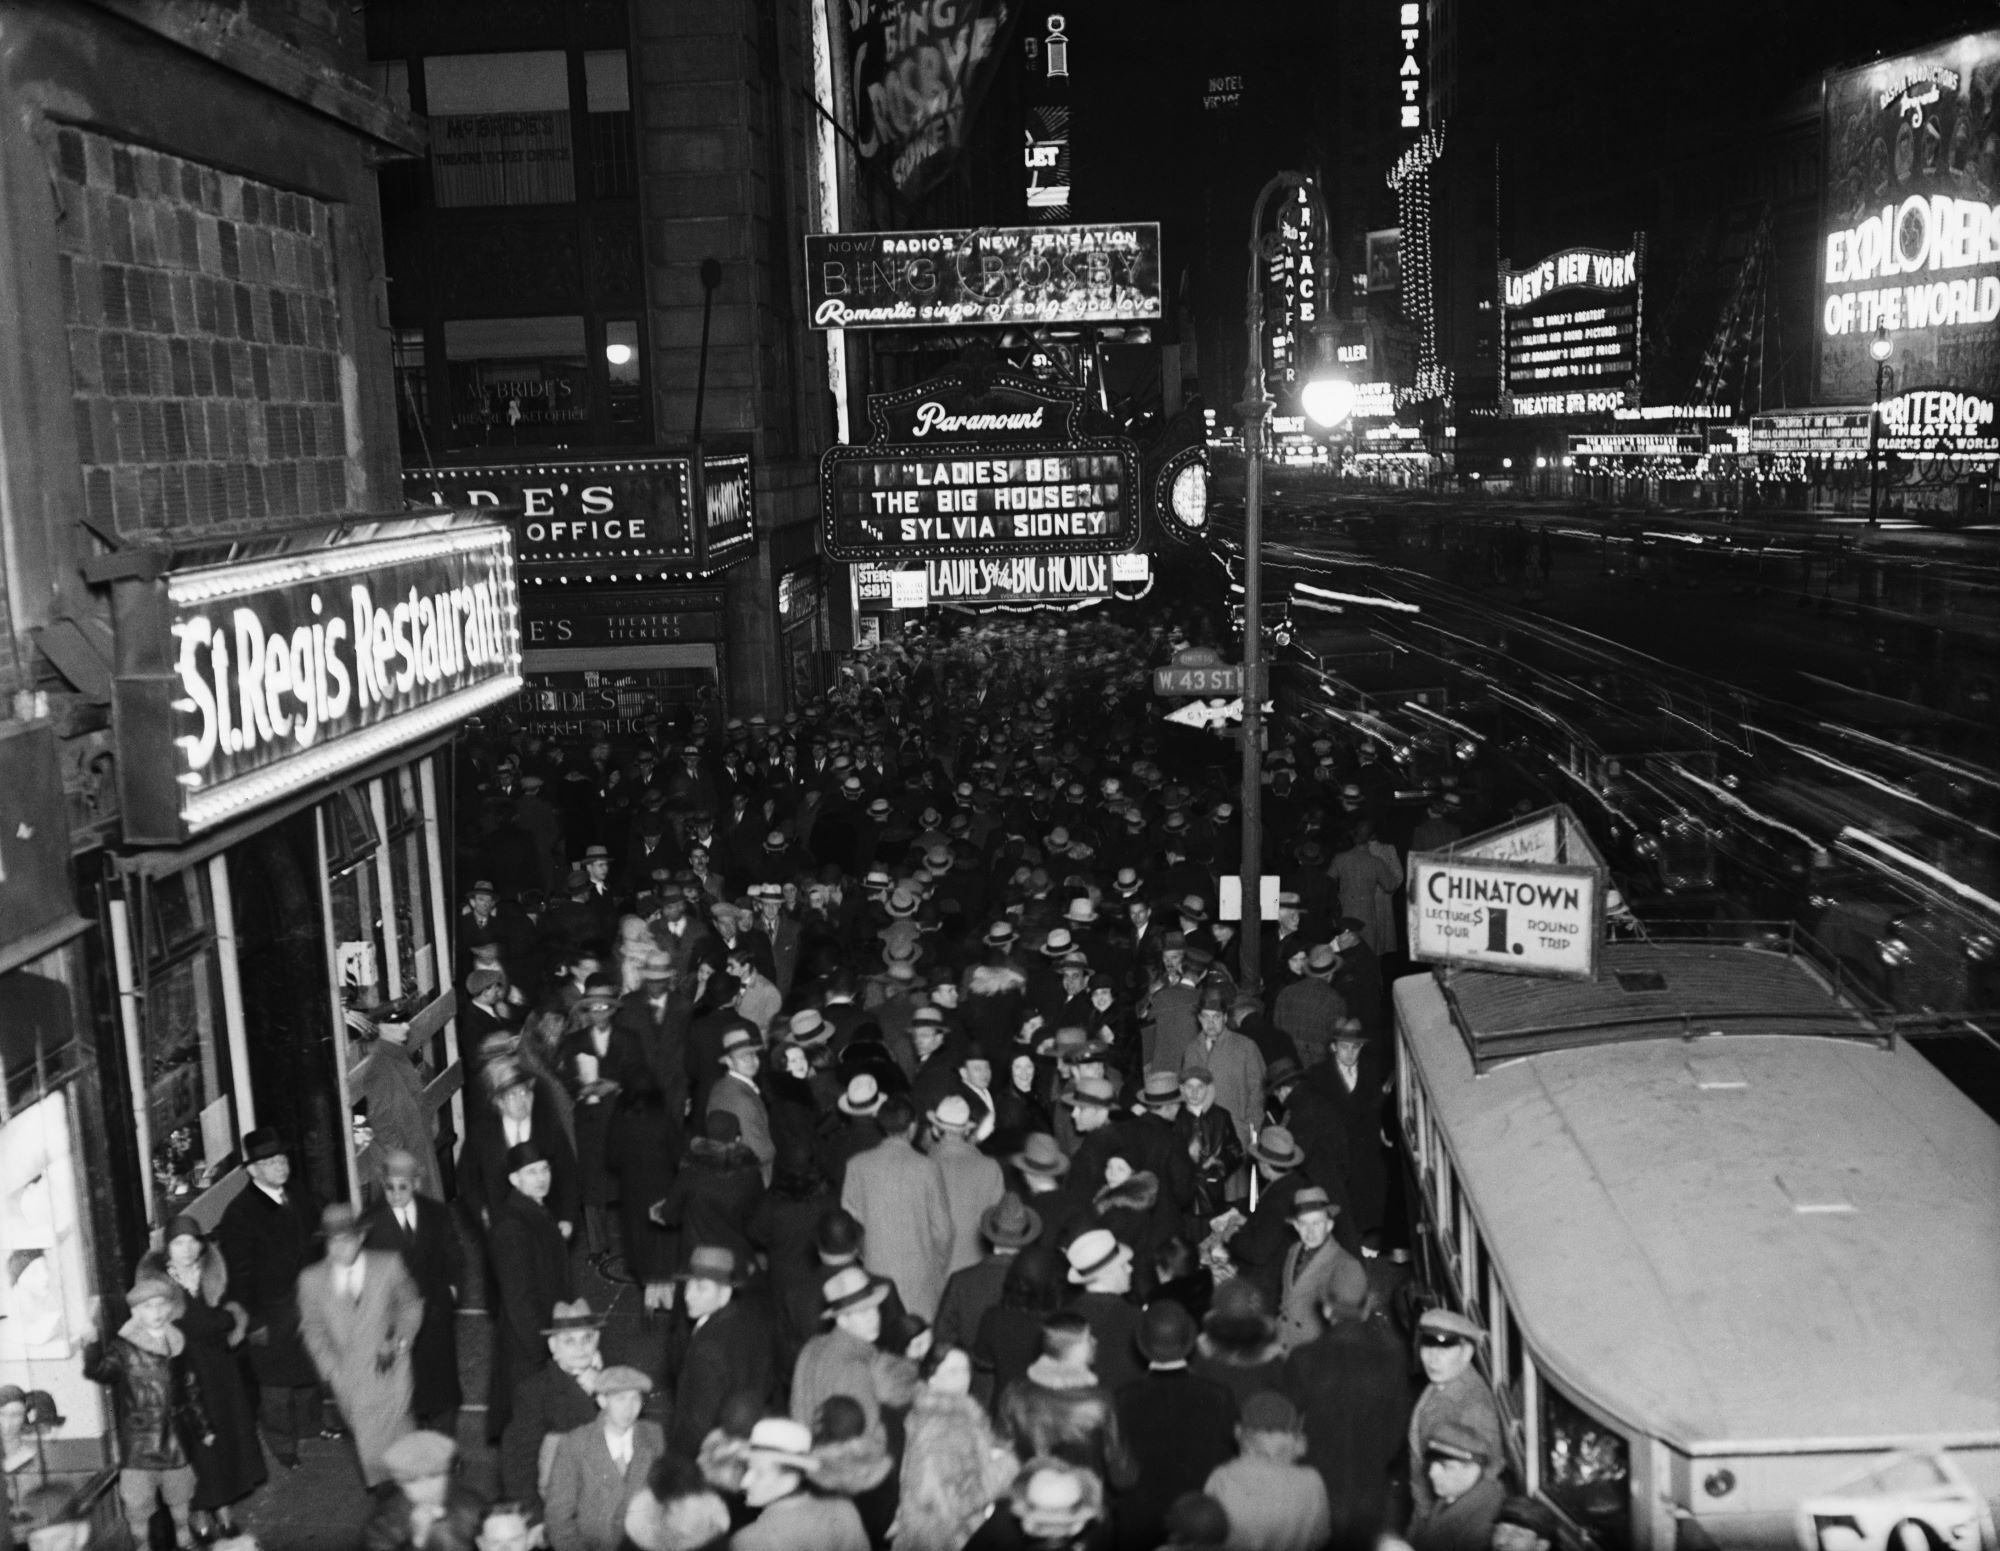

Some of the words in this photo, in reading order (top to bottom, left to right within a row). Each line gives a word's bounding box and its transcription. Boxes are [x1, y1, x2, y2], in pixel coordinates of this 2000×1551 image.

[1400, 3, 1420, 128] STATE
[1208, 75, 1244, 93] HOTEL
[828, 236, 877, 253] NOW!
[883, 236, 954, 254] RADIO'S
[979, 235, 1020, 251] NEW
[1031, 231, 1137, 248] SENSATION
[823, 258, 937, 296] BING
[956, 227, 1143, 300] CROSBY
[1505, 262, 1555, 306] LOEW'S
[1558, 253, 1591, 287] NEW
[1592, 251, 1636, 288] YORK
[815, 298, 916, 326] Romantic
[921, 302, 982, 323] singer
[986, 299, 1007, 322] of
[1012, 299, 1070, 321] songs
[1076, 298, 1113, 318] you
[1115, 291, 1155, 312] love
[1285, 255, 1296, 382] MAYFAIR
[1824, 292, 1857, 336] OF
[1857, 286, 1902, 333] THE
[1904, 275, 2000, 329] WORLD
[1513, 395, 1565, 416] THEATRE
[1588, 391, 1625, 412] ROOF
[1880, 390, 1994, 424] CRITERION
[912, 401, 1044, 438] Paramount
[1888, 423, 1979, 436] THEATRE
[1923, 437, 1940, 450] OF
[1956, 437, 2000, 450] WORLD
[872, 491, 920, 514] THE
[936, 488, 978, 512] BIG
[526, 519, 646, 542] OFFICE
[861, 519, 884, 541] WITH
[900, 515, 995, 541] SYLVIA
[1013, 510, 1105, 536] SIDNEY
[928, 558, 992, 596] LADIES
[1012, 557, 1045, 594] BIG
[1047, 555, 1109, 593] HOUSE
[607, 615, 681, 628] THEATRE
[608, 627, 681, 639] TICKETS
[179, 615, 243, 769] St.
[233, 592, 351, 749] Regis
[351, 567, 504, 709] Restaurant
[1158, 672, 1175, 691] W.
[1180, 670, 1206, 690] 43
[1211, 670, 1234, 690] ST.
[1428, 871, 1579, 910] CHINATOWN
[1436, 924, 1470, 939] TOUR
[1527, 919, 1579, 936] ROUND
[1538, 936, 1571, 950] TRIP
